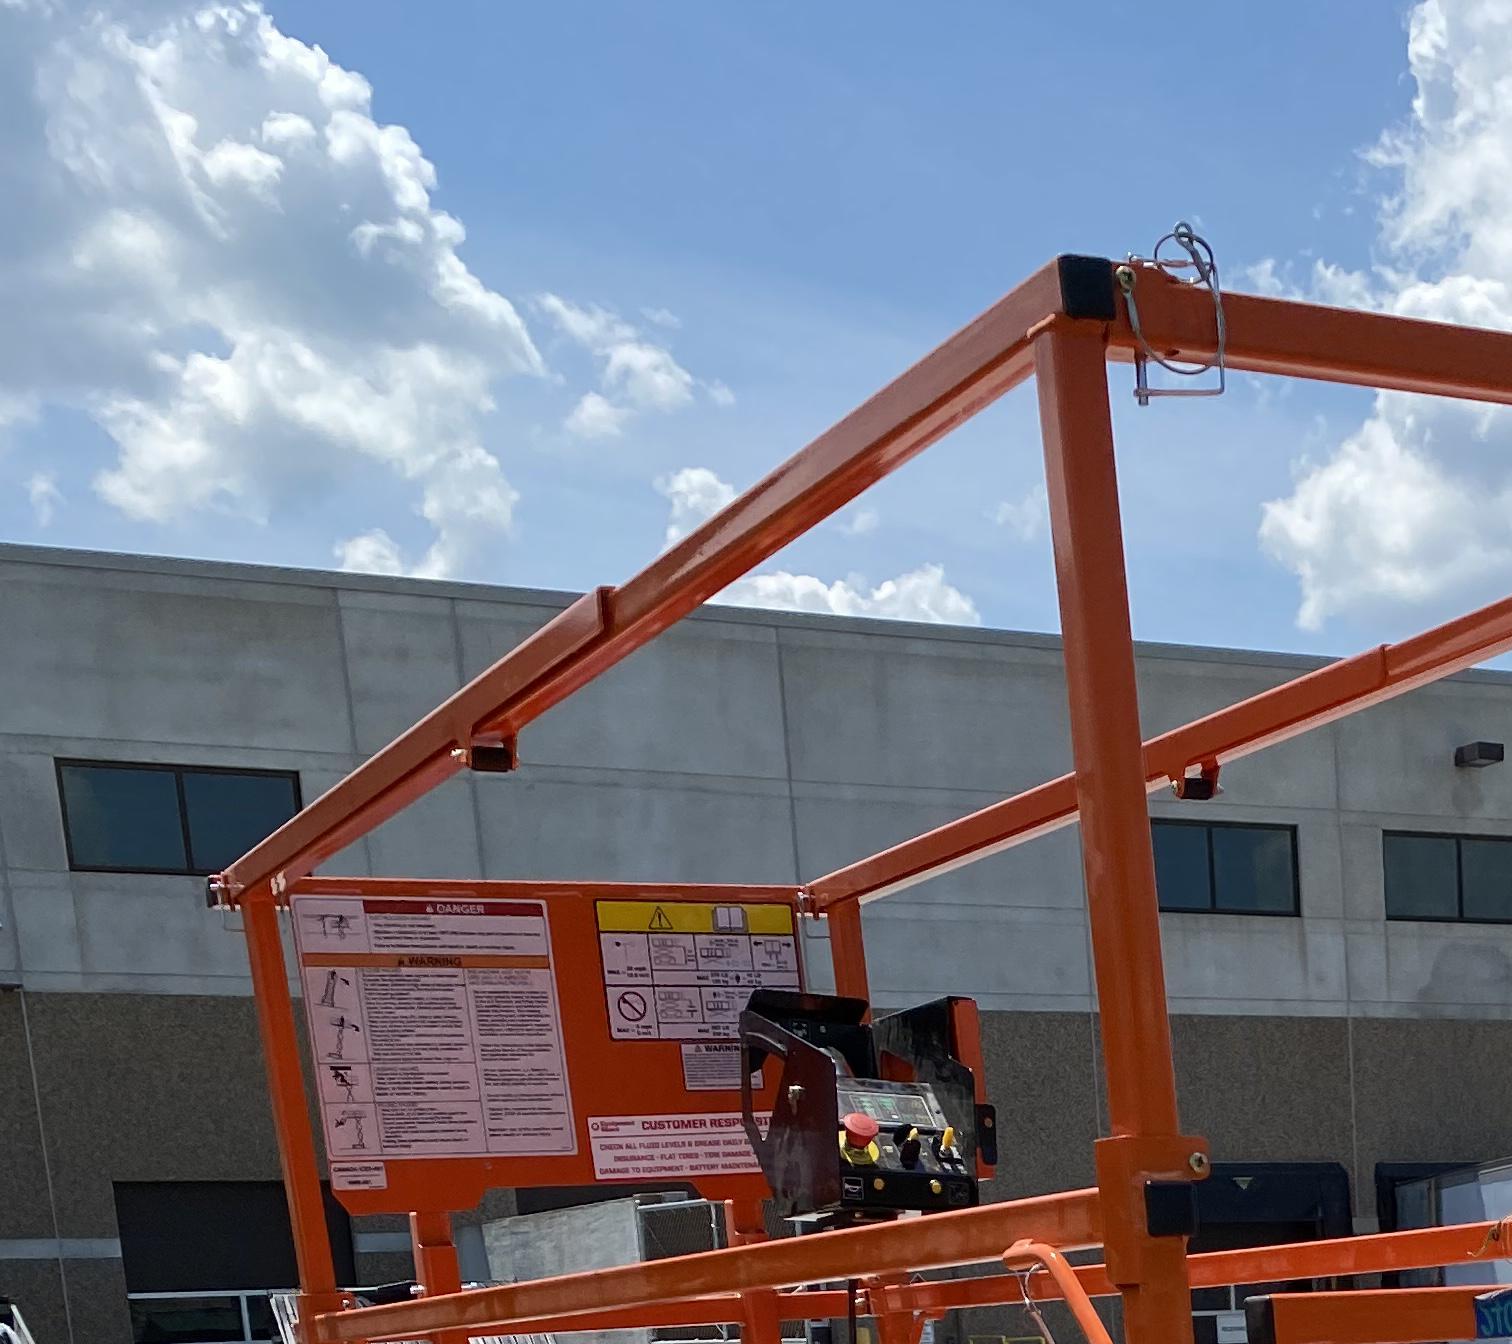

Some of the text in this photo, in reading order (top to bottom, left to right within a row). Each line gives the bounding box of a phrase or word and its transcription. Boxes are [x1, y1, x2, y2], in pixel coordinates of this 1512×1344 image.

[436, 904, 485, 914] DANGER
[408, 956, 463, 967] WARNING
[704, 1044, 742, 1052] WARNIN
[641, 1118, 707, 1131] CUSTOMER
